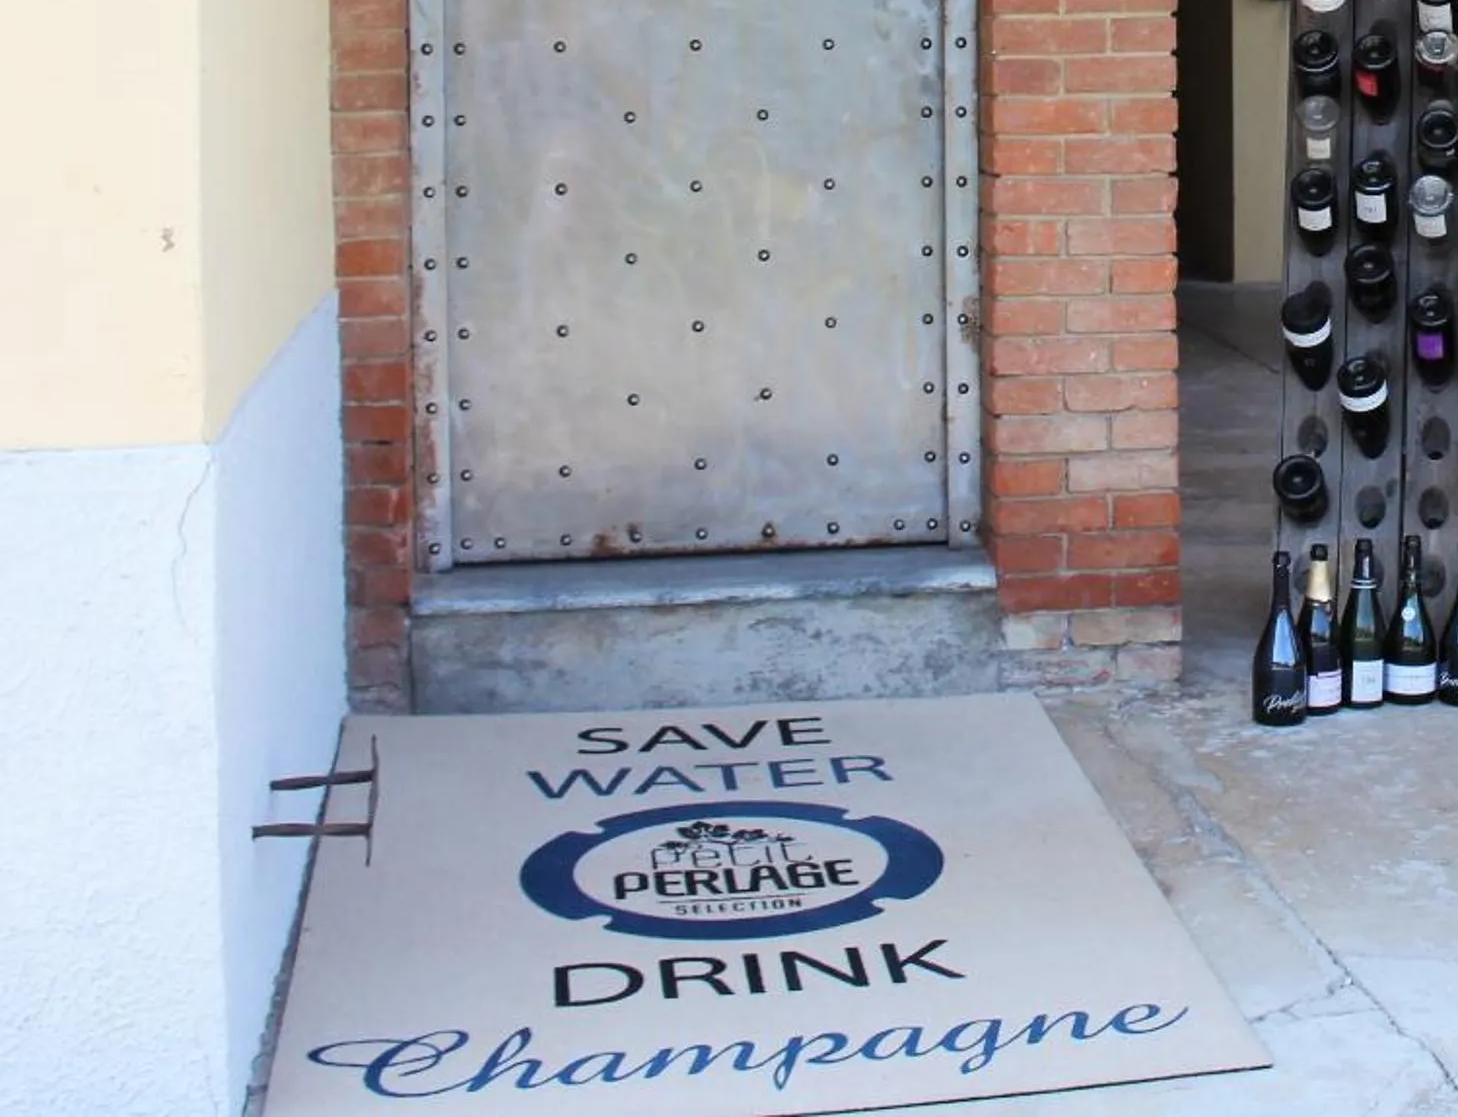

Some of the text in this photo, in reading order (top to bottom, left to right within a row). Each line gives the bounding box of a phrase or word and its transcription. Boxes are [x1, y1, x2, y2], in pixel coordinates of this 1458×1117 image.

[577, 716, 831, 755] SAVE
[527, 754, 895, 800] WATER
[613, 858, 860, 900] PERLAGE
[673, 898, 803, 916] SELECTION
[553, 938, 967, 1008] DRINK
[307, 1002, 1190, 1099] Champagne
